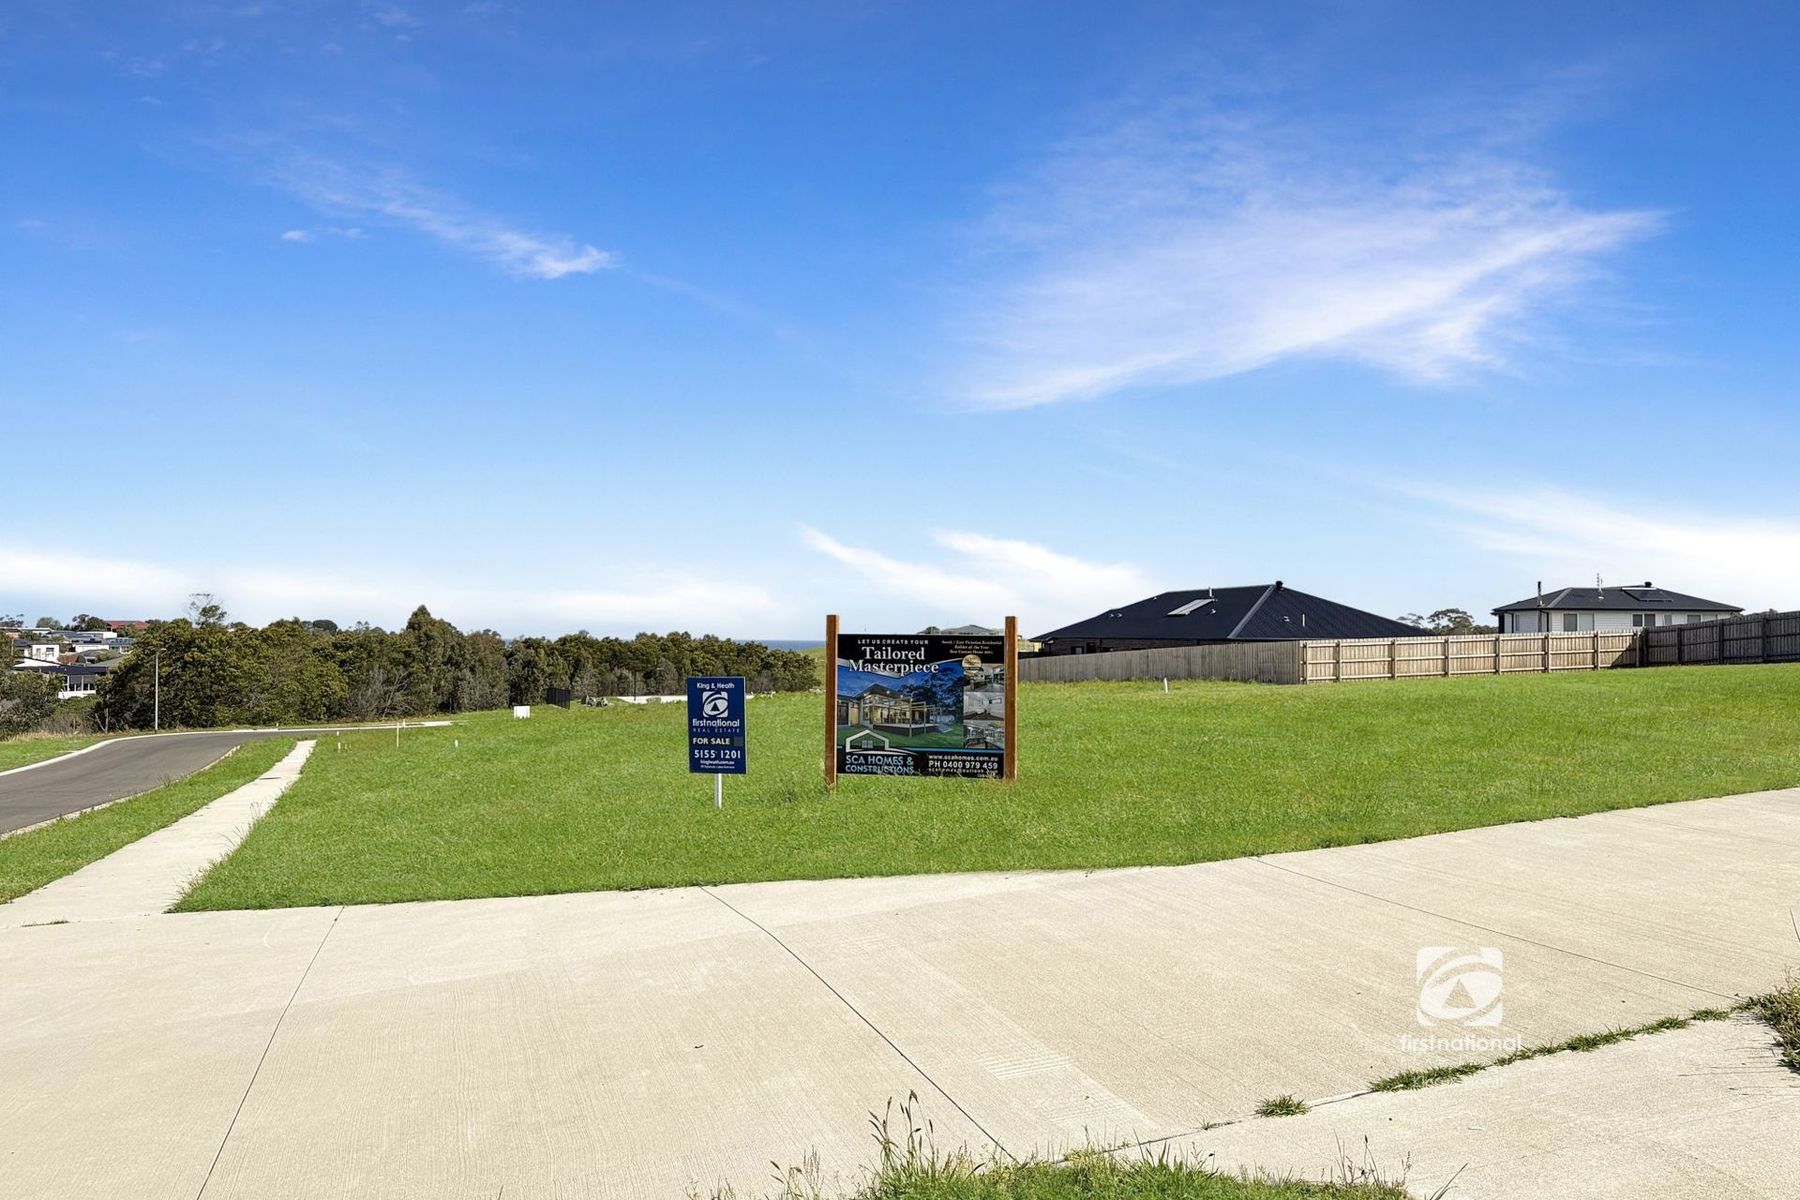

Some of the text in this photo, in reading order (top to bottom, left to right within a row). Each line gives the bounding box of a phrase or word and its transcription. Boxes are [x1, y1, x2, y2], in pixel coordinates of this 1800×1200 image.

[861, 646, 925, 660] Tailored
[849, 659, 939, 677] Masterpiece
[692, 737, 731, 745] FOR SALE
[694, 749, 741, 759] 5155 1201
[845, 755, 914, 765] SCA HOMES &
[928, 760, 999, 770] PH 0400 979 459
[845, 765, 914, 774] CONSTRUCTIONS
